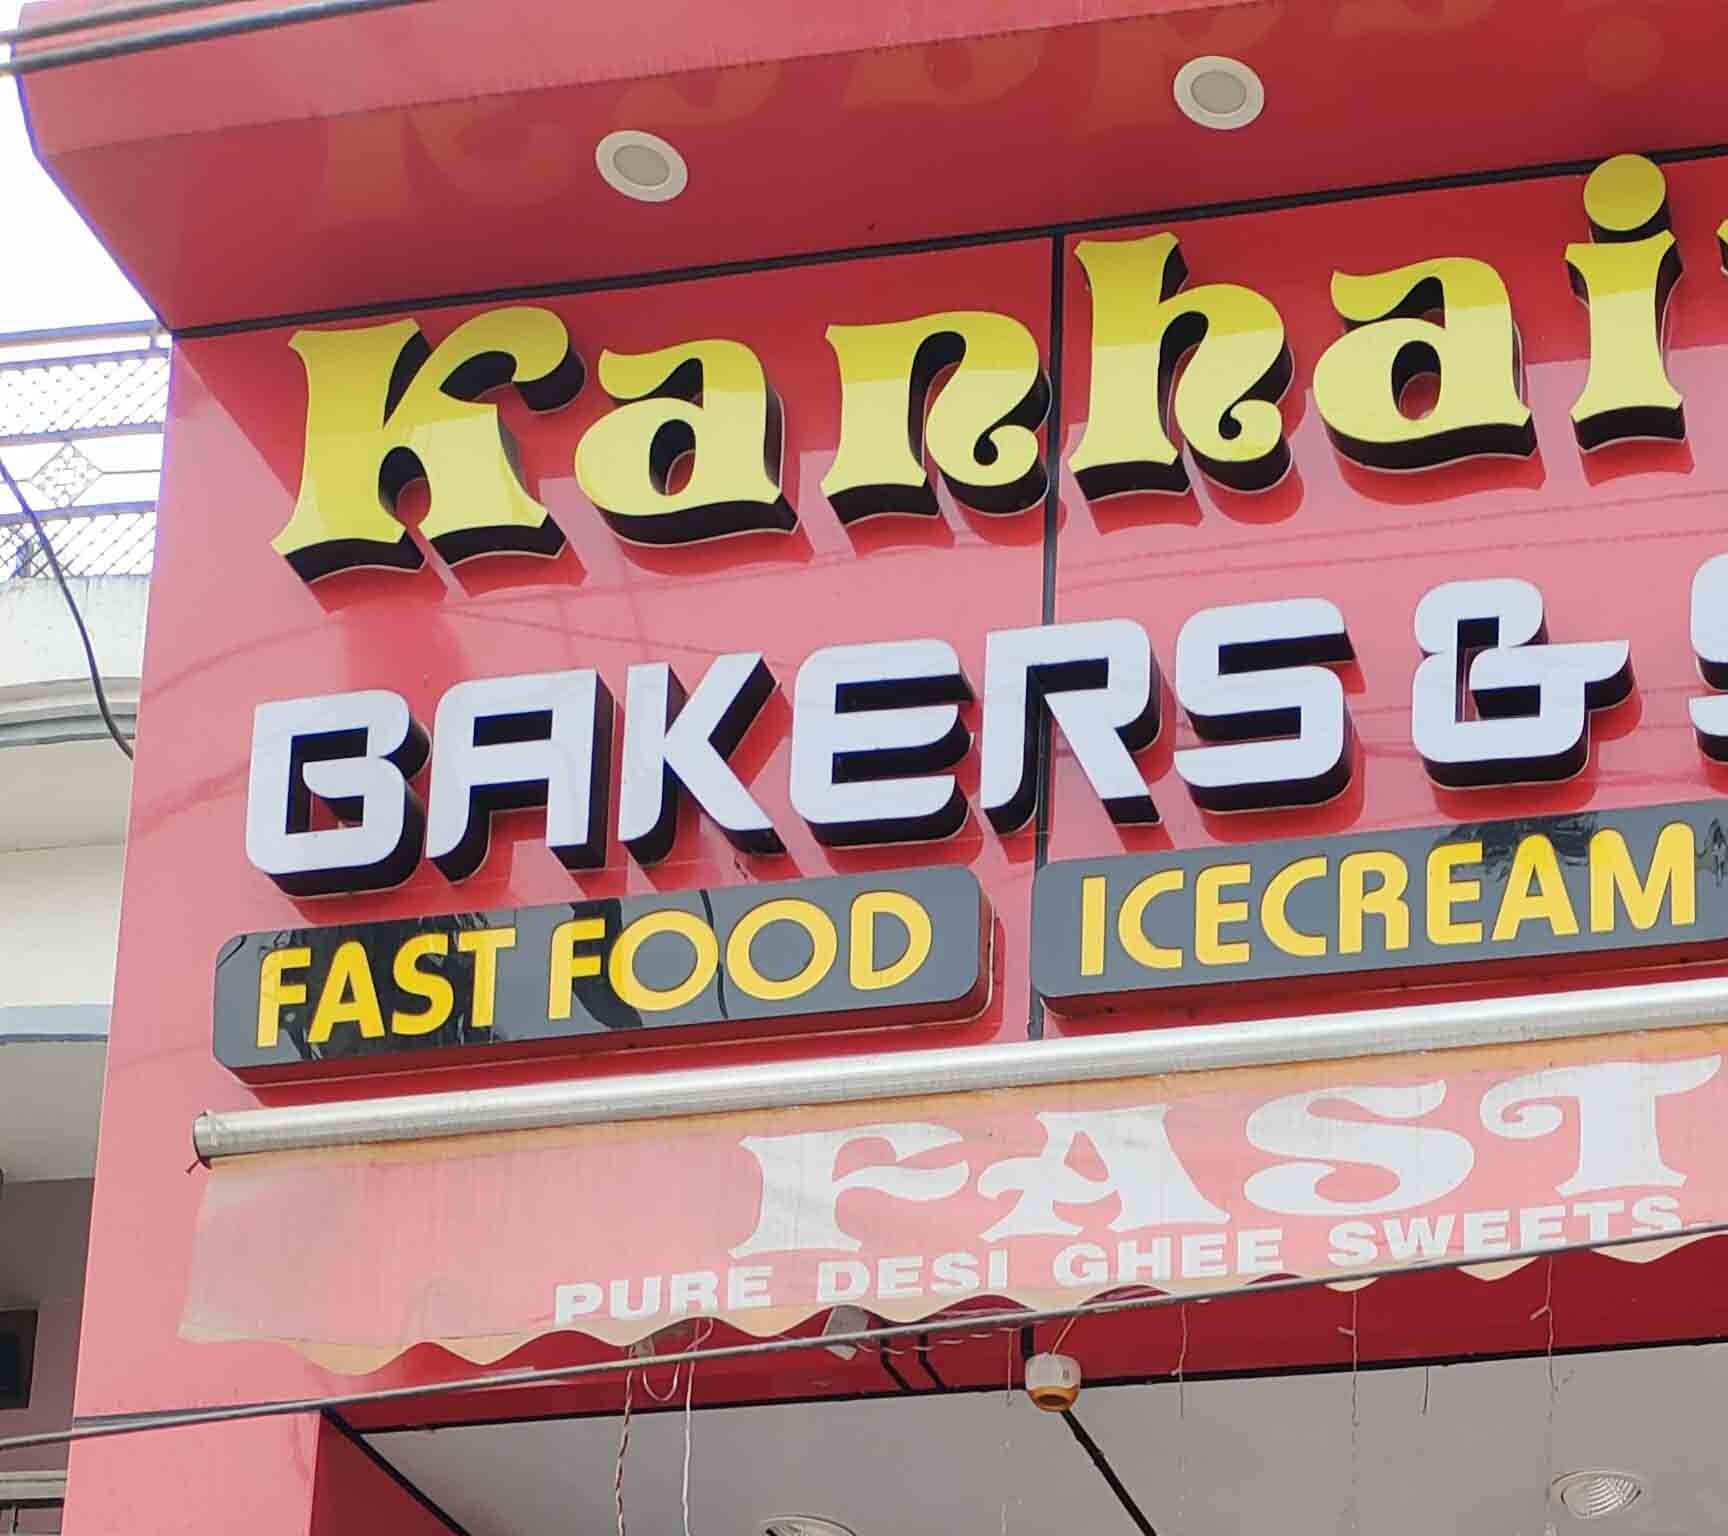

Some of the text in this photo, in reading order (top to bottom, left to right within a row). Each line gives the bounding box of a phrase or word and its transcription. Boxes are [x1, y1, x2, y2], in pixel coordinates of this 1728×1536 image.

[245, 598, 1353, 890] BAKERS
[1412, 577, 1632, 785] &
[257, 891, 933, 1047] FAST FOOD
[1080, 821, 1696, 977] ICECREAM
[729, 1053, 1721, 1258] FAST
[554, 1265, 773, 1328] PURE
[816, 1249, 1007, 1303] DESI
[1054, 1228, 1283, 1286] GHEE
